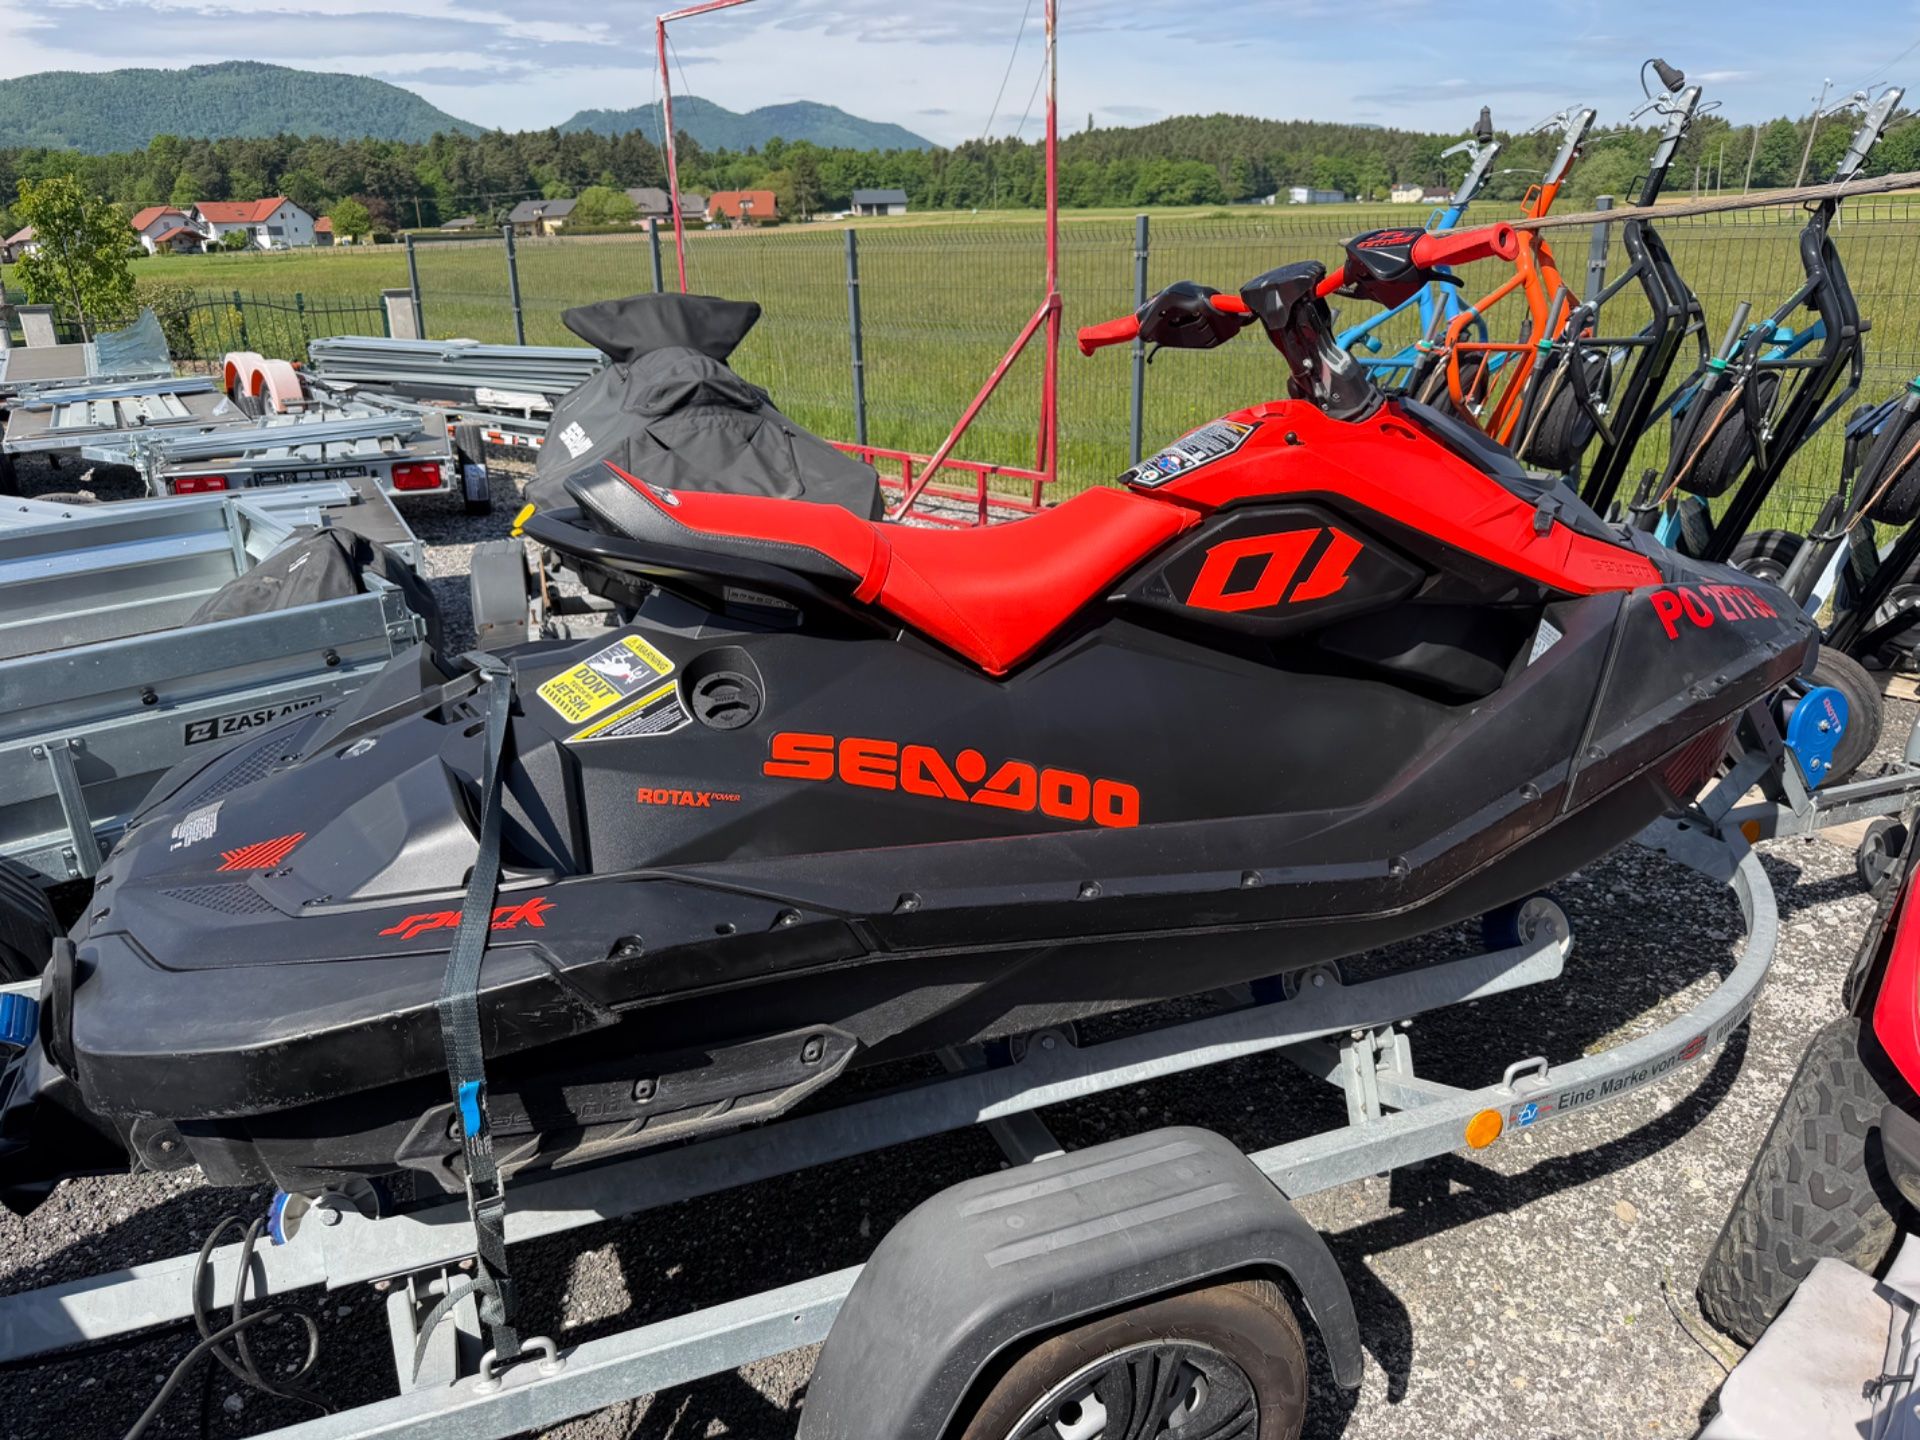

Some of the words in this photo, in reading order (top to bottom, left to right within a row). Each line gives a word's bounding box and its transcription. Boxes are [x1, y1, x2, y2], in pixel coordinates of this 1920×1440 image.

[1649, 586, 1715, 640] PO
[637, 642, 669, 671] WARNING
[552, 681, 592, 713] JET-SKI
[573, 667, 615, 699] DONT
[637, 787, 711, 807] ROTAX
[1557, 1087, 1596, 1111] Eine
[1600, 1068, 1648, 1096] Marke
[1652, 1058, 1676, 1076] von
